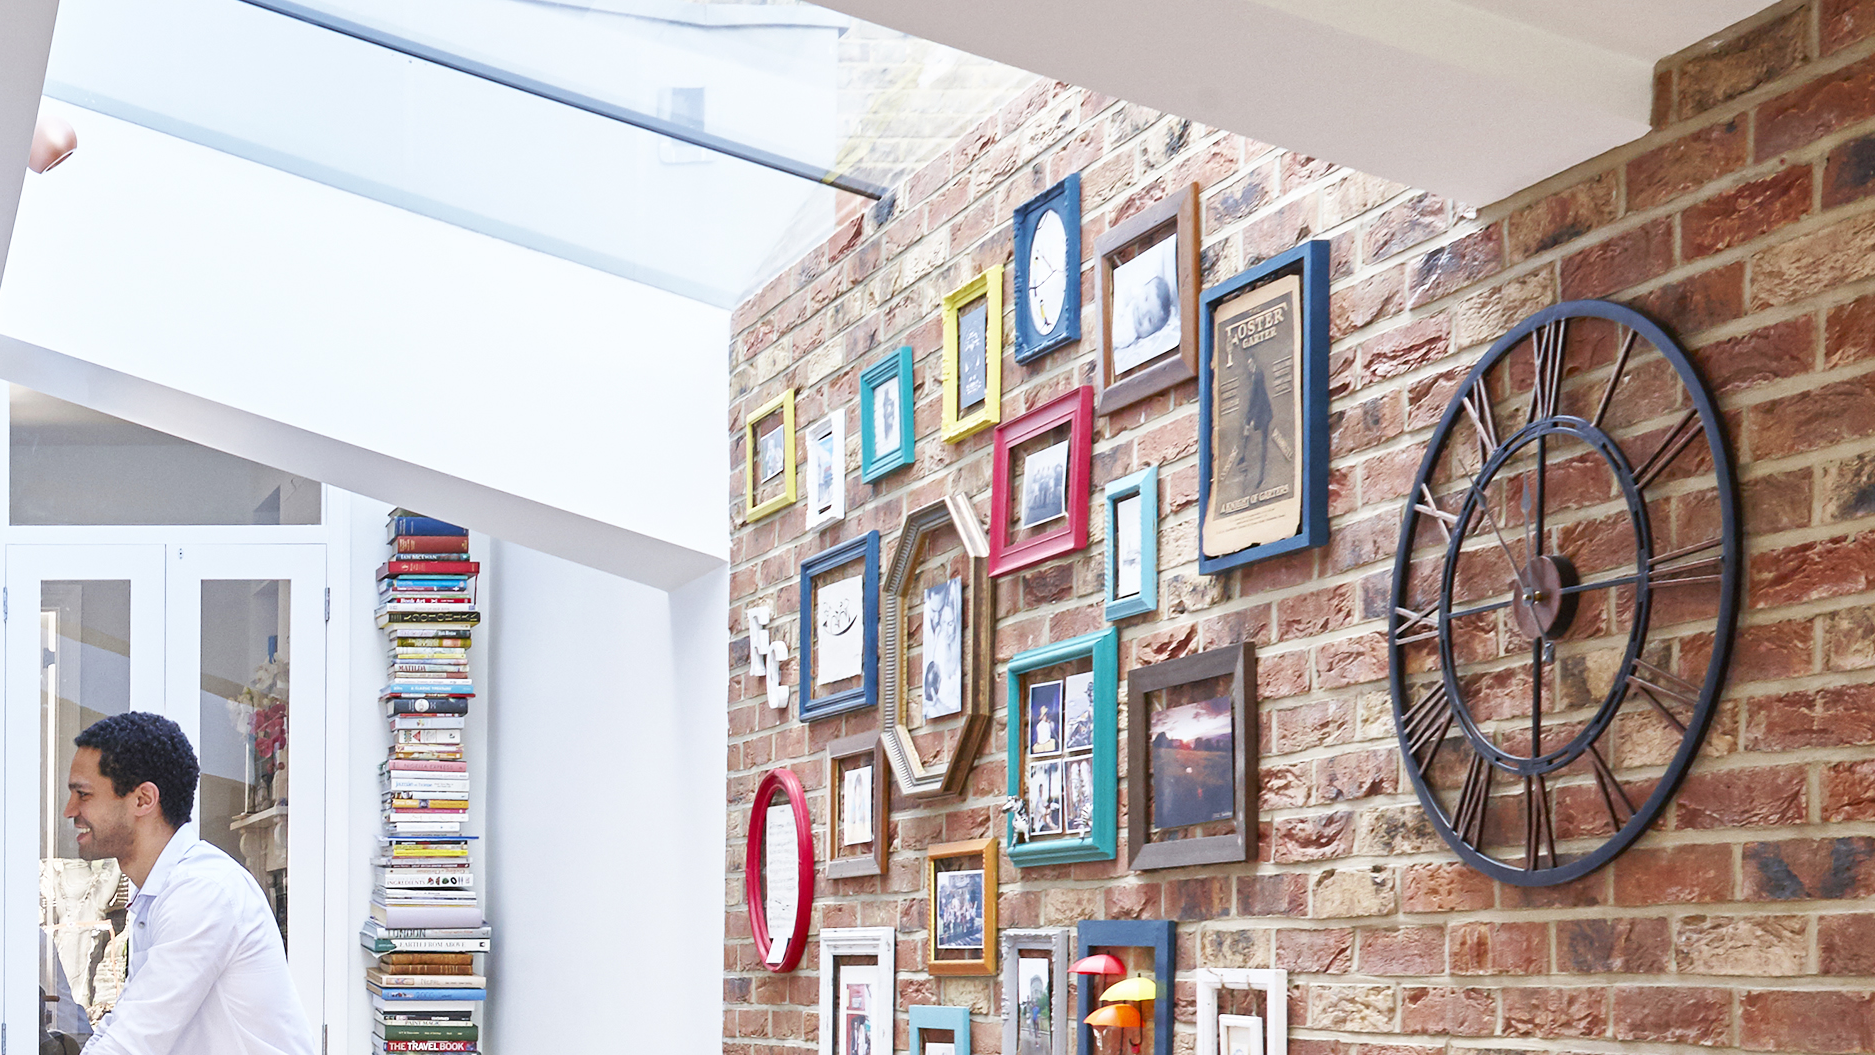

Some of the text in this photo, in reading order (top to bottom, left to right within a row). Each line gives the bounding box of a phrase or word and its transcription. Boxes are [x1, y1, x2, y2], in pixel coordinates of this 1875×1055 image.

[1225, 302, 1288, 368] FOSTER
[1243, 327, 1277, 349] GARTER
[403, 613, 477, 622] MYTHOLOGY
[388, 929, 425, 937] LONDON
